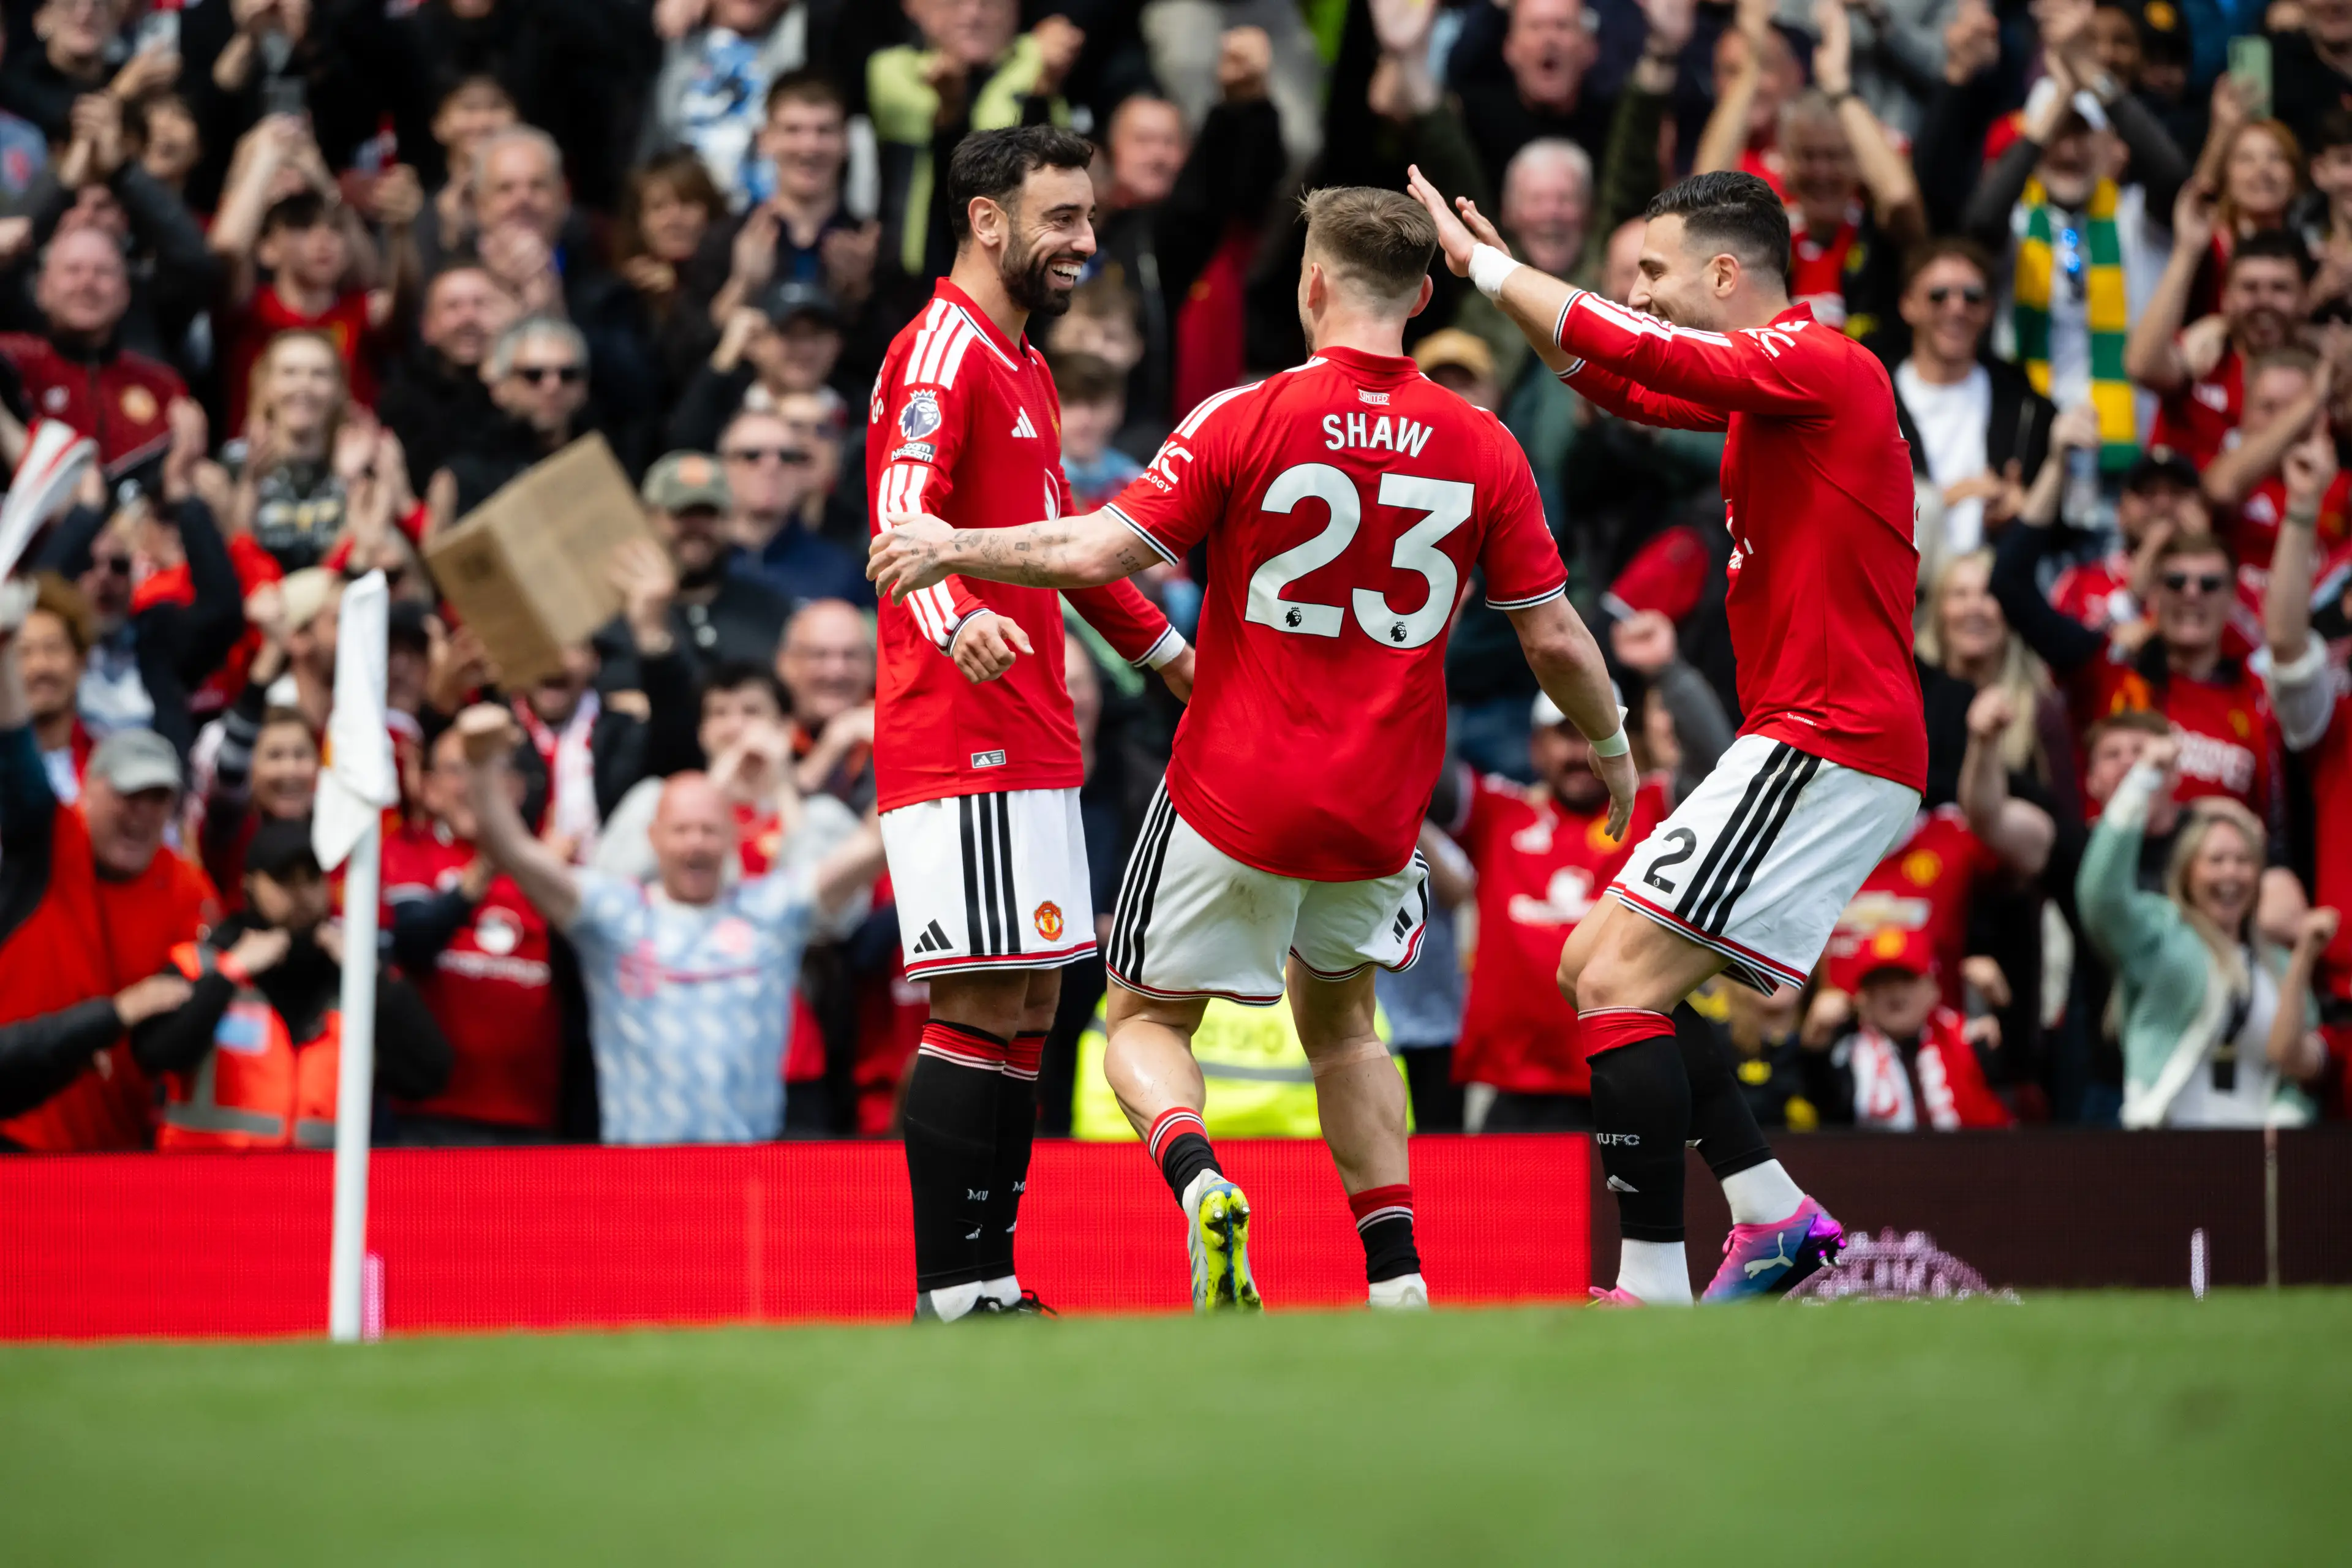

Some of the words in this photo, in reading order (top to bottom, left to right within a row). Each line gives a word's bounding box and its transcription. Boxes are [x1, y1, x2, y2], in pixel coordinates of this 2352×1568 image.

[1360, 392, 1389, 403] UNITED
[1322, 412, 1434, 458] SHAW
[1245, 462, 1475, 649] 23
[1643, 827, 1697, 894] 2
